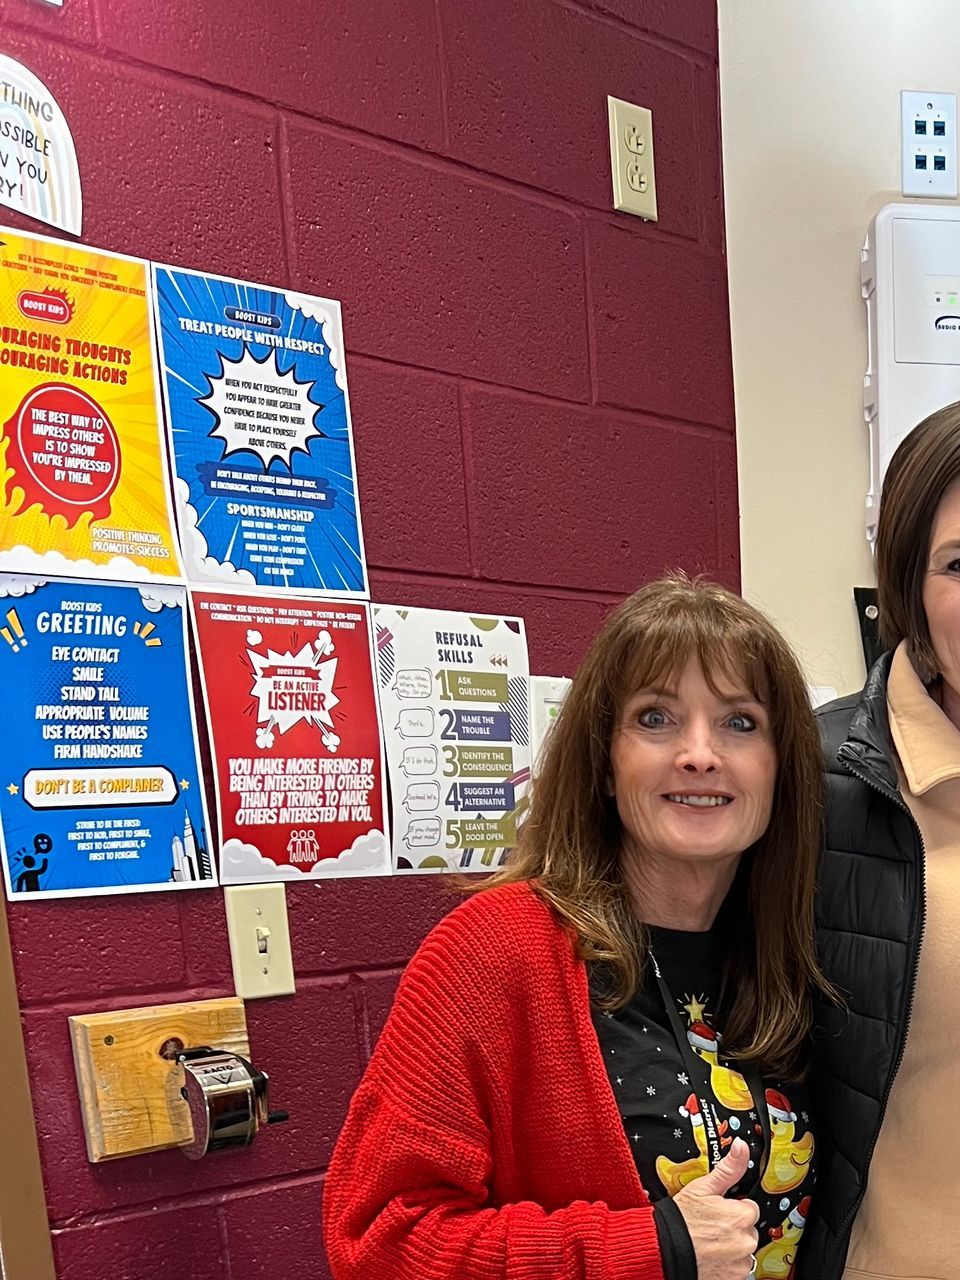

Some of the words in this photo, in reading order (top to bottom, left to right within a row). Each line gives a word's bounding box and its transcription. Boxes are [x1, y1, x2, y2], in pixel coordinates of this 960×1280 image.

[0, 81, 53, 122] THING
[0, 121, 51, 157] SSIBLE
[16, 157, 47, 184] YOU
[24, 299, 46, 311] BOOST
[48, 303, 64, 315] KIDS
[235, 311, 255, 322] BOOST
[257, 314, 272, 325] KIDS
[0, 326, 61, 354] URAGING
[178, 317, 213, 334] TREAT
[215, 324, 253, 342] PEOPLE
[254, 331, 282, 348] WITH
[285, 338, 325, 356] RESPECT
[0, 348, 69, 375] OURAGING
[73, 361, 128, 385] ACTIONS
[241, 381, 251, 389] YOU
[253, 383, 262, 391] ACT
[225, 392, 236, 401] YOU
[258, 396, 264, 404] TO
[31, 408, 46, 421] THE
[49, 411, 69, 424] BEST
[71, 415, 90, 428] WAY
[92, 417, 103, 429] TO
[32, 423, 70, 440] IMPRESS
[72, 429, 104, 444] OTHERS
[46, 440, 54, 451] IS
[57, 441, 68, 453] TO
[70, 444, 95, 457] SHOW
[32, 452, 62, 467] YOU'RE
[65, 457, 111, 473] IMPRESSED
[55, 470, 65, 481] BY
[68, 472, 93, 485] THEM.
[227, 503, 314, 523] SPORTSMANSHIP
[93, 528, 126, 540] POSITIVE
[127, 531, 162, 544] THINKING
[93, 543, 135, 554] PROMOTES
[136, 546, 169, 558] SUCCESS
[61, 601, 85, 611] BOOST
[86, 602, 102, 612] KIDS
[36, 612, 126, 636] GREETING
[435, 632, 483, 647] REFUSAL
[52, 646, 70, 661] EYE
[72, 647, 120, 663] CONTACT
[438, 649, 473, 664] SKILLS
[72, 667, 104, 681] SMILE
[61, 686, 96, 701] STAND
[97, 687, 120, 701] TALL
[273, 681, 281, 690] BE
[284, 681, 293, 690] AN
[296, 682, 319, 691] ACTIVE
[435, 670, 452, 701] 1
[458, 677, 472, 685] ASK
[459, 689, 496, 697] QUESTIONS
[268, 692, 326, 711] LISTENER
[35, 705, 104, 720] APPROPRIATE
[110, 706, 149, 720] VOLUME
[43, 725, 63, 739] USE
[65, 725, 110, 739] PEOPLE'S
[113, 725, 147, 739] NAMES
[438, 709, 456, 740] 2
[461, 715, 481, 724] NAME
[482, 716, 494, 724] THE
[462, 726, 490, 735] TROUBLE
[54, 745, 80, 759] FIRM
[82, 745, 142, 758] HANDSHAKE
[229, 758, 251, 774] YOU
[253, 758, 284, 774] MAKE
[286, 758, 317, 774] MORE
[361, 759, 374, 774] BY
[442, 745, 457, 777] 3
[35, 780, 70, 795] DON'T
[72, 780, 86, 793] BE
[88, 780, 96, 793] A
[100, 778, 164, 793] COMPLAINER
[229, 775, 262, 792] BEING
[264, 774, 323, 791] INTERESTED
[325, 774, 335, 790] IN
[337, 774, 375, 790] OTHERS
[240, 791, 268, 808] THAN
[270, 792, 285, 808] BY
[287, 791, 323, 807] TRYING
[325, 791, 338, 806] TO
[340, 790, 368, 806] MAKE
[445, 782, 459, 811] 4
[464, 787, 493, 795] SUGGEST
[465, 798, 505, 806] ALTERNATIVE
[236, 808, 277, 825] OTHERS
[279, 807, 336, 824] INTERESTED
[338, 806, 349, 822] IN
[351, 806, 372, 822] YOU.
[446, 820, 460, 848] 5
